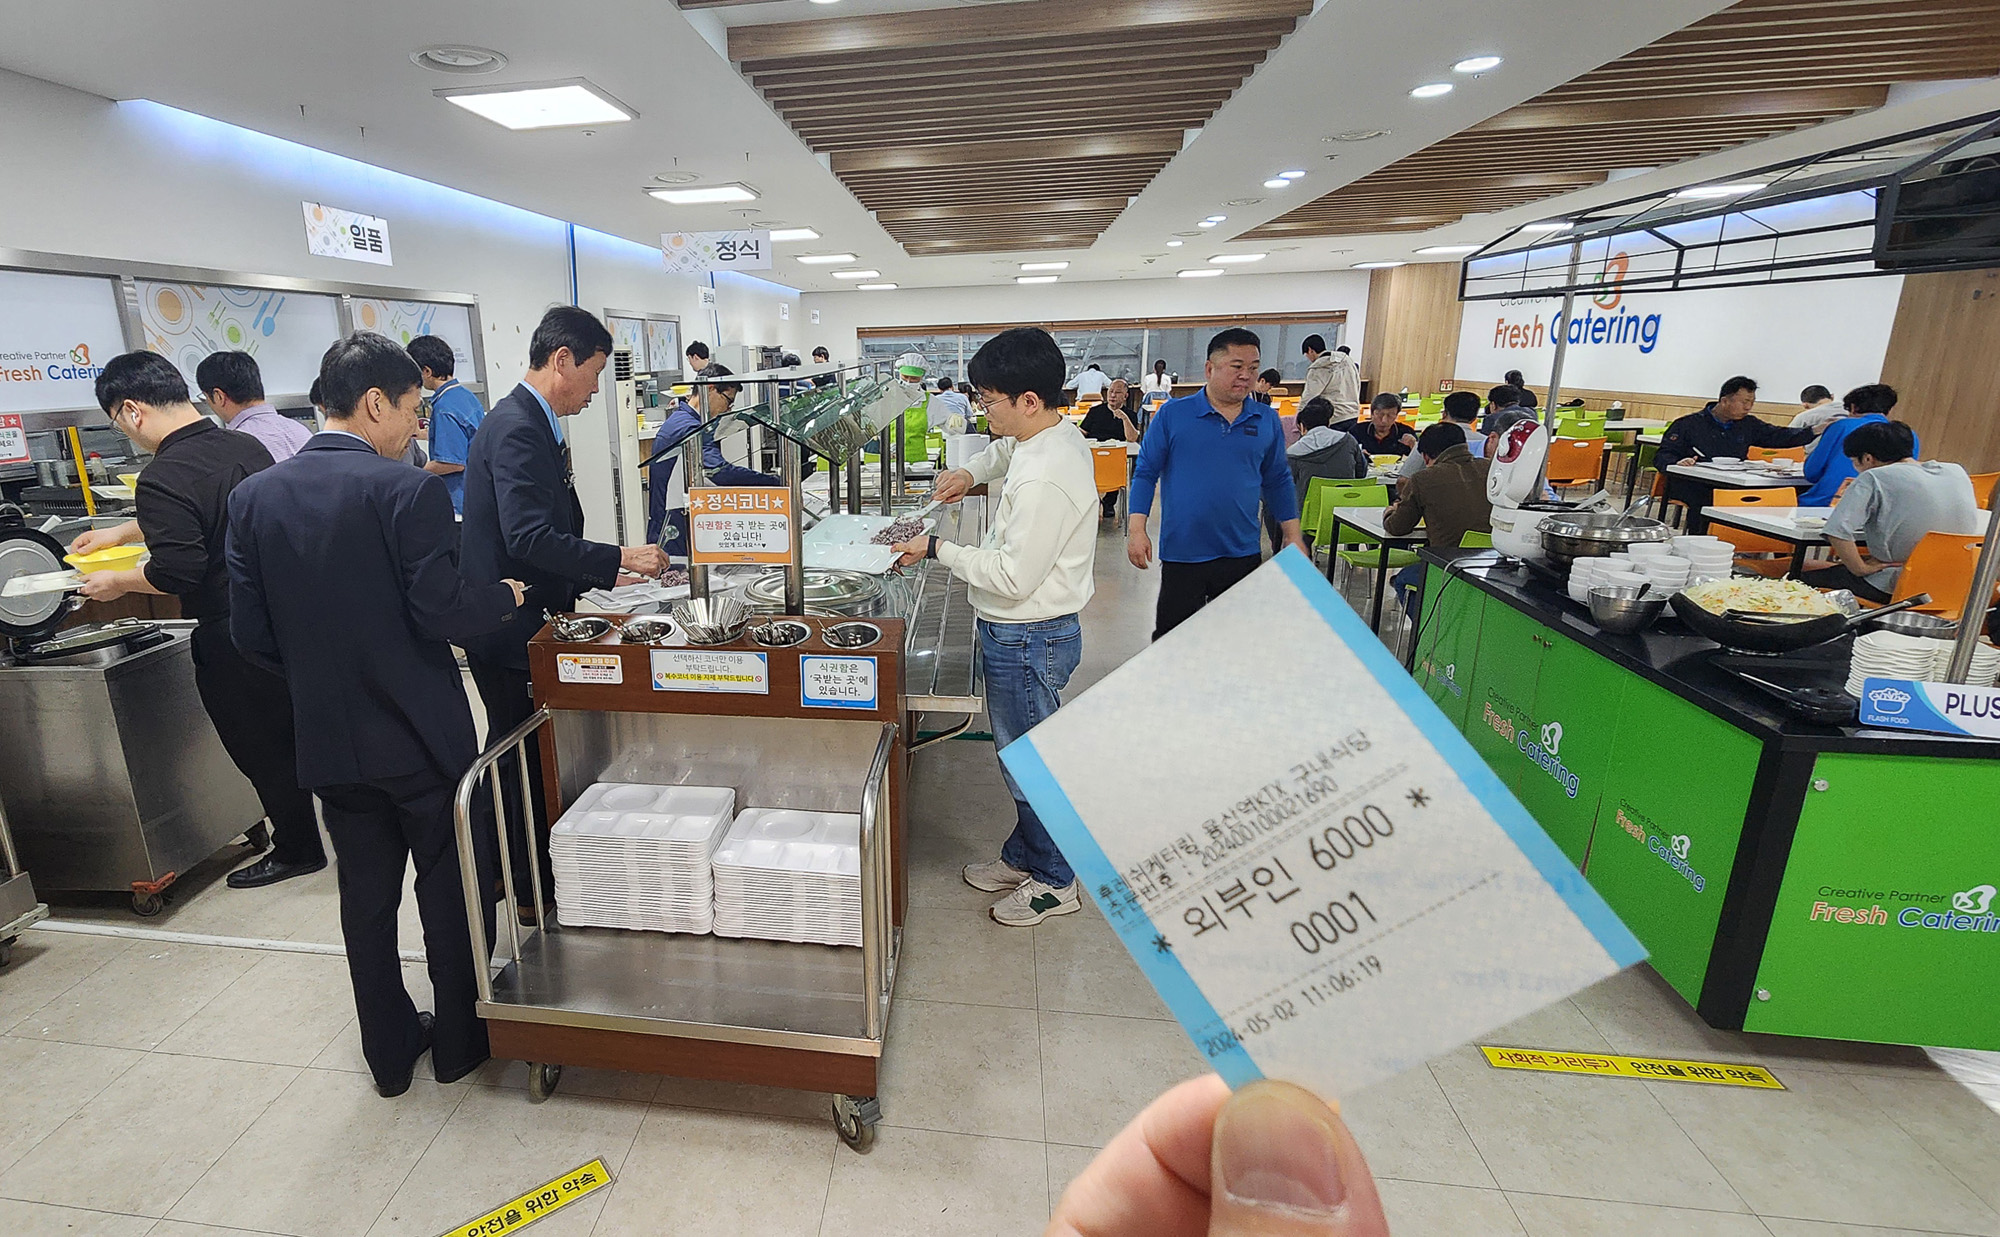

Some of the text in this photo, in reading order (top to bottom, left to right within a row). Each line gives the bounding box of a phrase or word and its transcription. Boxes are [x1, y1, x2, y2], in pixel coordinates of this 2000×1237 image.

[350, 224, 383, 254] 일품
[715, 239, 760, 261] 정식
[1493, 305, 1662, 354] Fresh Catering
[0, 351, 67, 361] reative Partner
[47, 363, 105, 380] Caterin
[706, 493, 770, 511] 정식코너
[696, 520, 787, 531] 식권함은 국 받는 곳에
[723, 531, 762, 541] 있습니다!
[672, 653, 744, 665] 선택하신 코너만 이용
[685, 664, 733, 673] 부탁드립니다.
[819, 662, 859, 674] 식권함은
[690, 673, 703, 681] 이용
[717, 674, 754, 683] 부탁드립니다
[818, 685, 861, 697] 있습니다.
[1487, 686, 1515, 714] Creative
[1944, 692, 2000, 720] PLUS
[1867, 714, 1910, 725] FLASH FOOD
[1482, 701, 1580, 799] Fresh Catering
[1202, 780, 1288, 840] 용산역KTX
[1289, 728, 1371, 782] 구내식당
[1199, 775, 1340, 868] 202400100021690
[1615, 808, 1706, 893] Fresh Catering
[1183, 856, 1301, 937] 외부인
[1308, 804, 1394, 871] 6000
[1818, 886, 1947, 904] Creative Partner
[1290, 890, 1378, 954] 0001
[1810, 901, 1888, 926] Fresh
[1202, 998, 1299, 1058] 2024-05-02
[1301, 954, 1383, 1006] 11:06:19
[1498, 1051, 1768, 1084] 사회적 거리두기 안전을 위한 약속
[467, 1171, 597, 1237] 안전을 위한 약속
